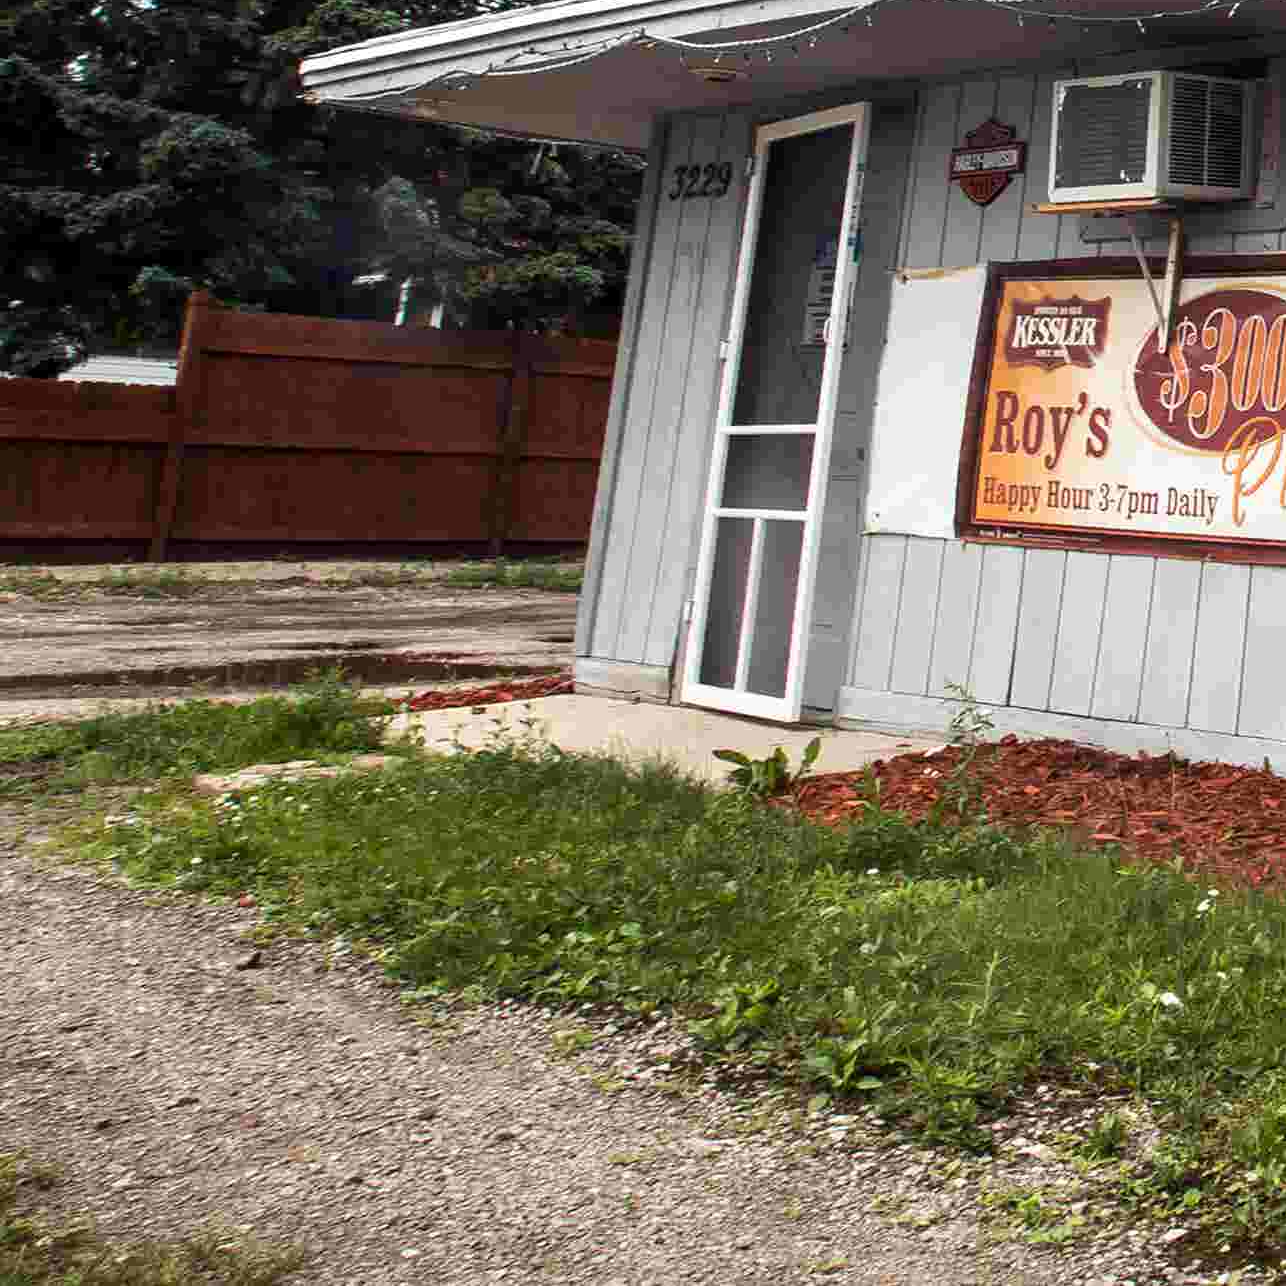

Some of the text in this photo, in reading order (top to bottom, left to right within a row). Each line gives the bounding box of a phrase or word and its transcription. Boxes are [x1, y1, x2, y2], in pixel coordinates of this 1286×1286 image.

[668, 161, 733, 201] 3229
[1011, 314, 1097, 348] KESSLER
[988, 390, 1112, 469] Roy's
[983, 476, 1219, 525] Happy Hour 3-7pm Daily
